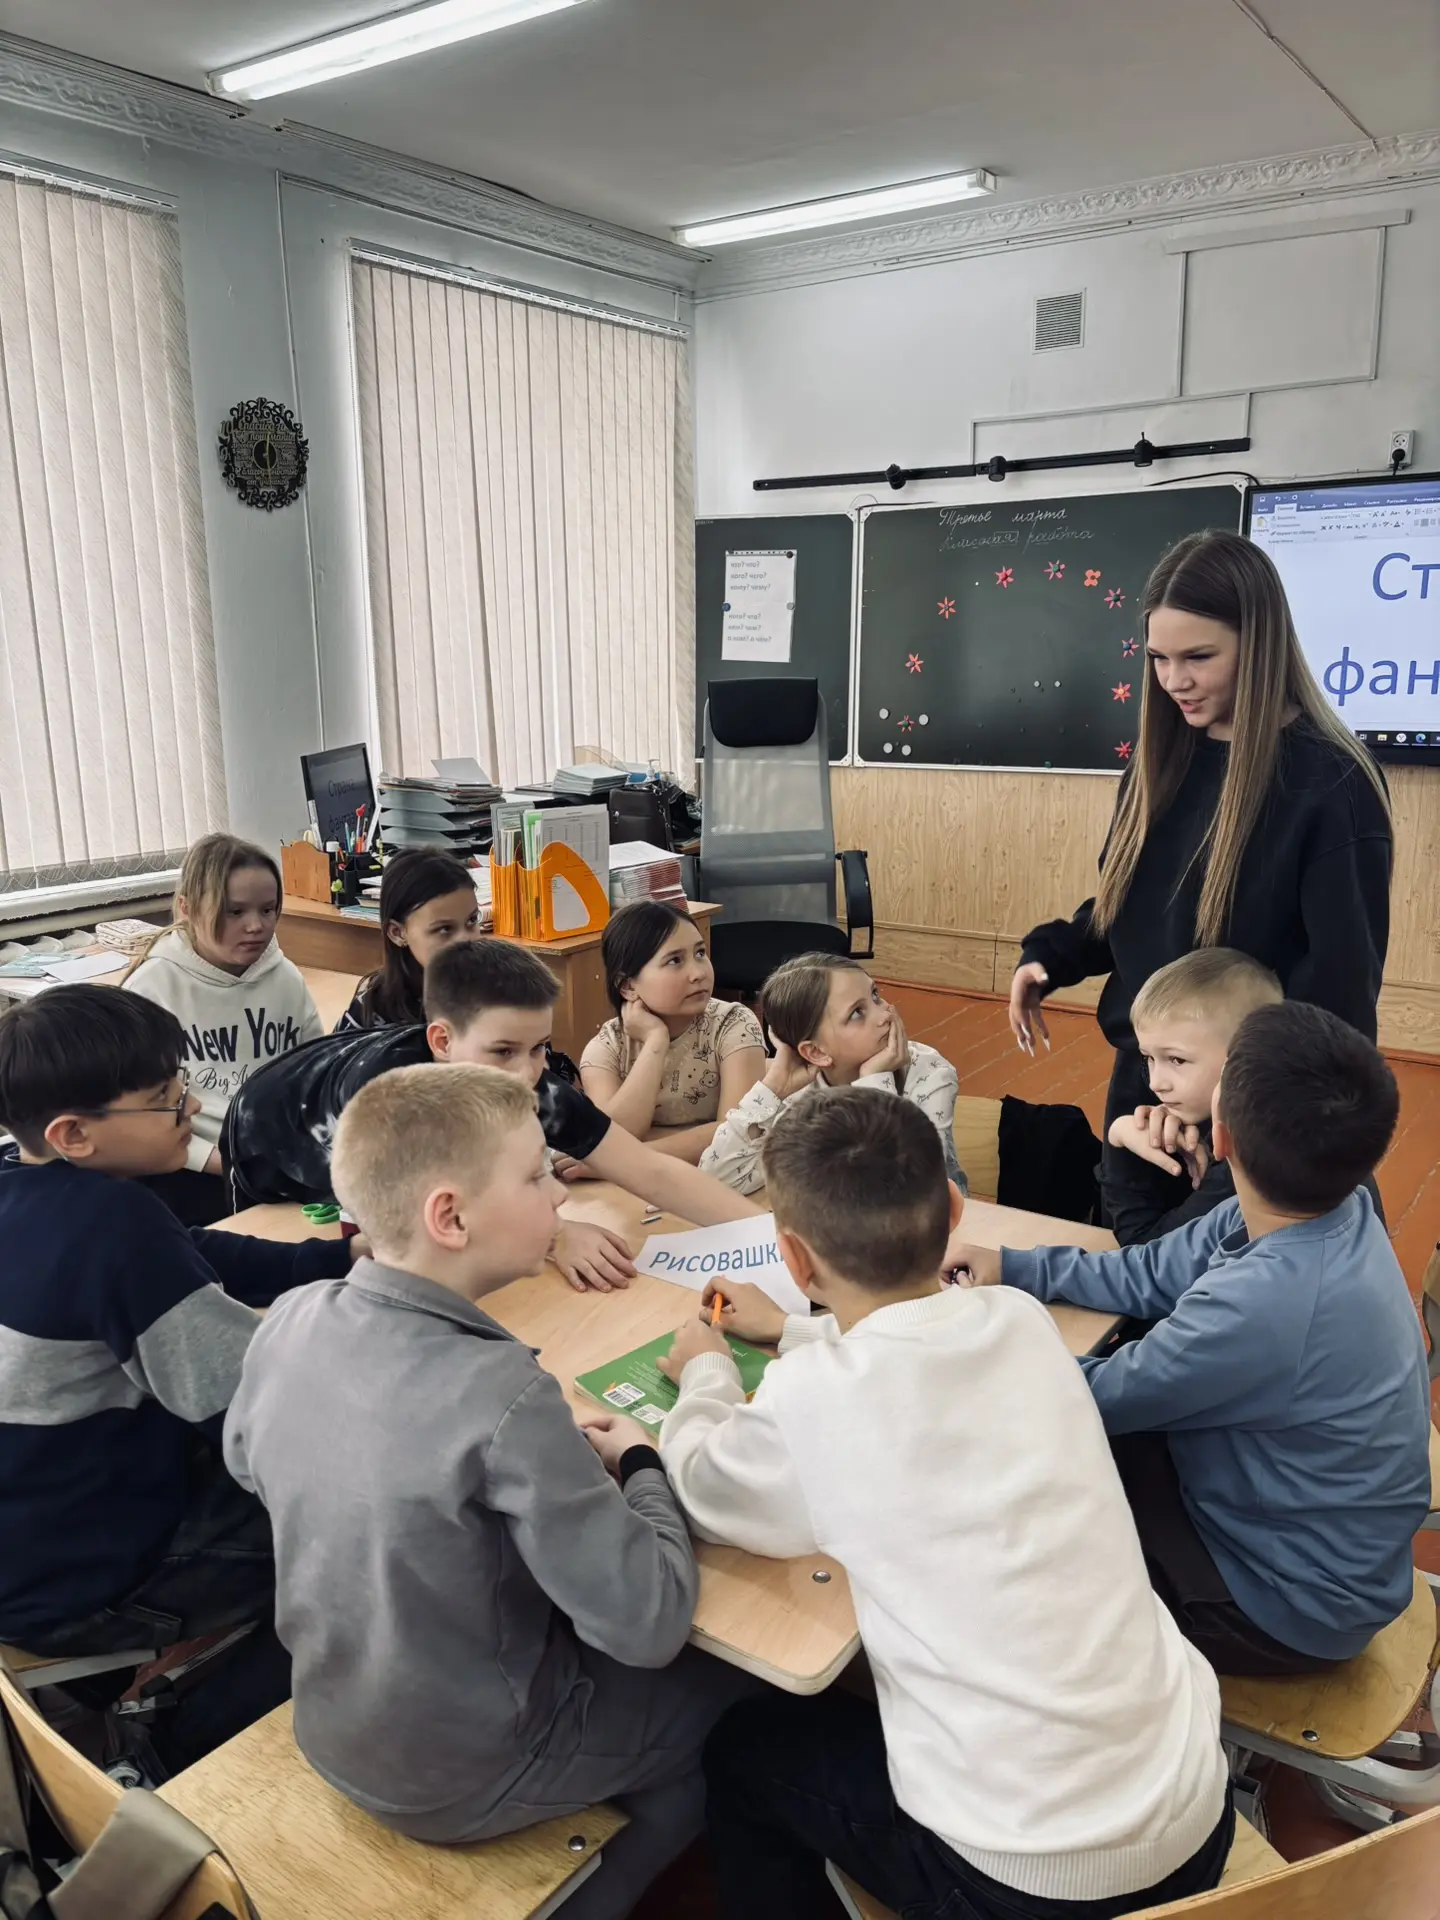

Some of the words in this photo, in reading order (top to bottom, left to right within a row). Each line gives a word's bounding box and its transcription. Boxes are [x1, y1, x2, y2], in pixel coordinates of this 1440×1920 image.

[939, 507, 993, 535] Третье
[1011, 508, 1068, 527] марта
[1021, 526, 1096, 555] работа
[1372, 552, 1440, 601] Ст
[1323, 646, 1440, 707] фан
[182, 1024, 238, 1063] New
[244, 1007, 300, 1060] York
[194, 1067, 231, 1096] Big
[648, 1242, 784, 1273] Рисовашк
